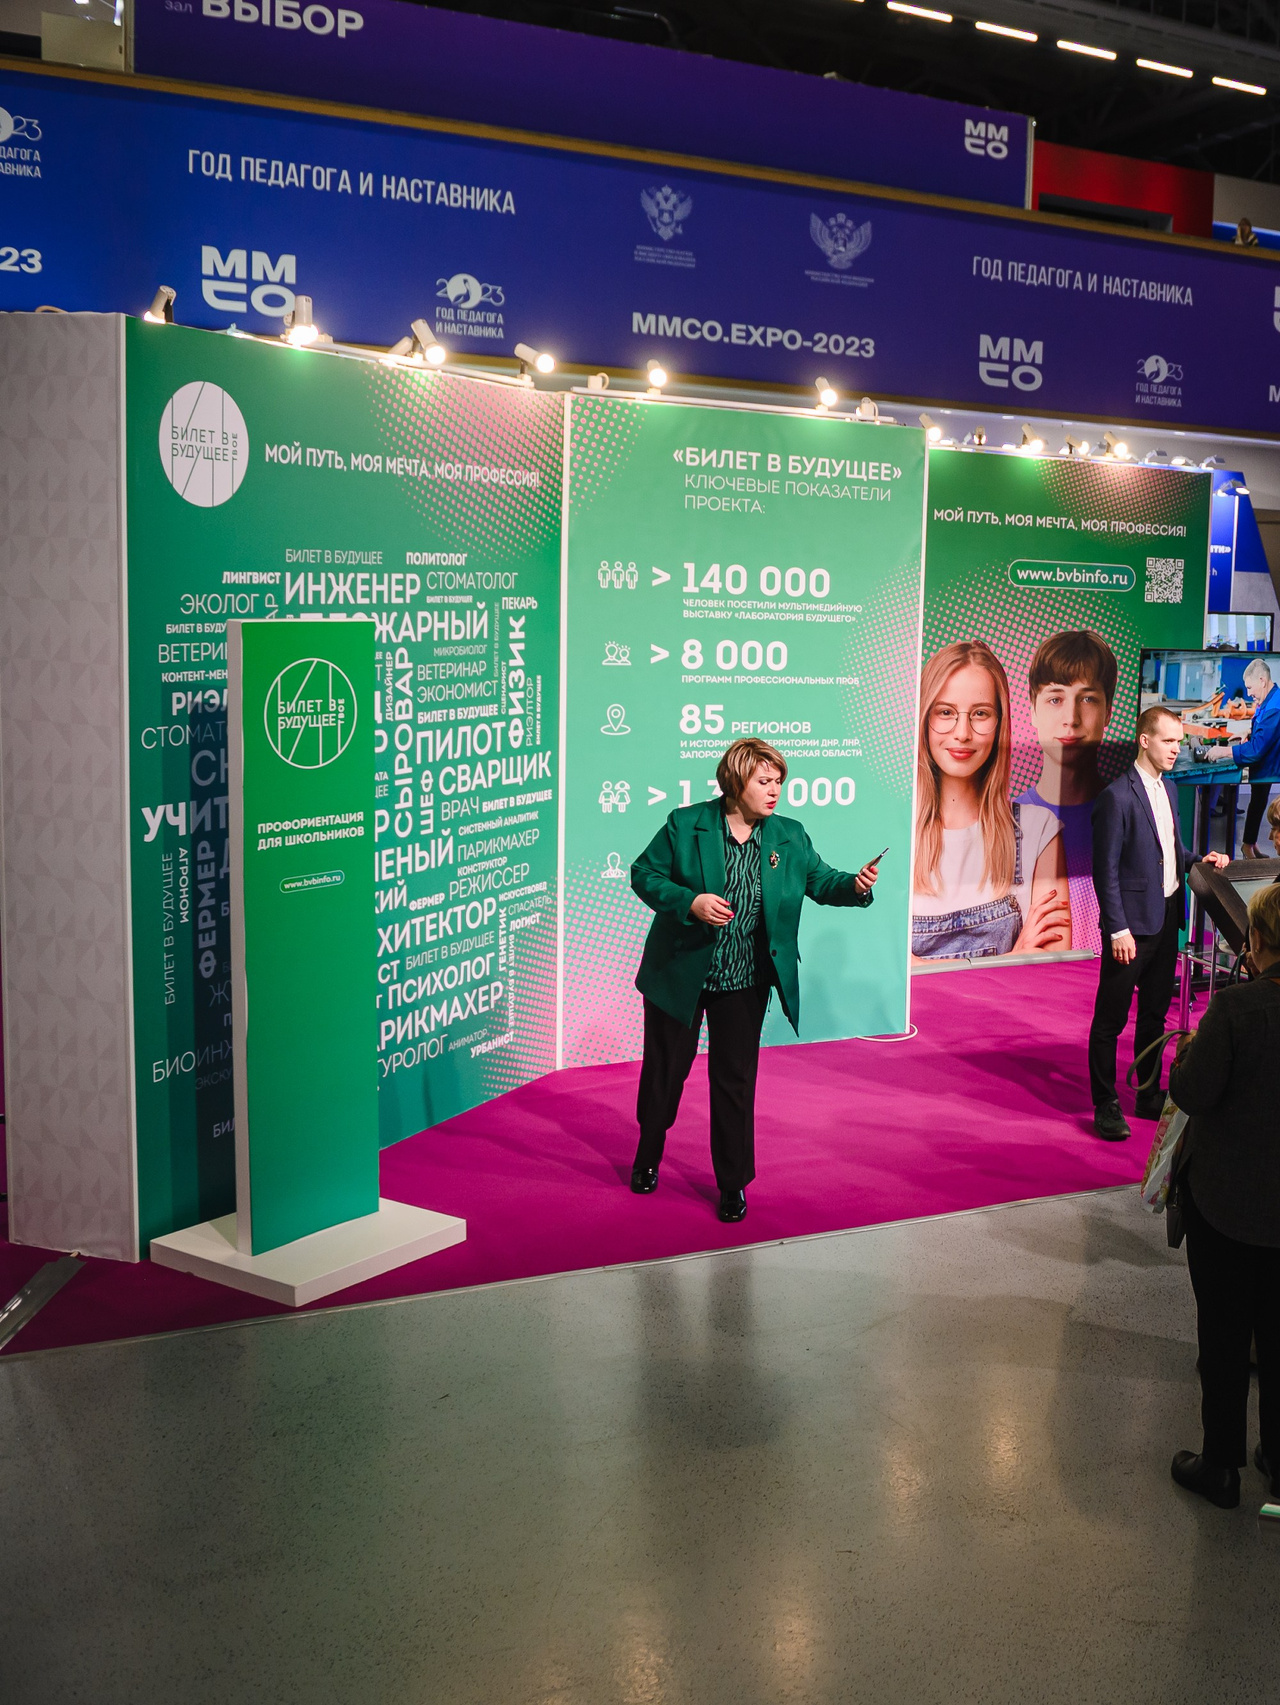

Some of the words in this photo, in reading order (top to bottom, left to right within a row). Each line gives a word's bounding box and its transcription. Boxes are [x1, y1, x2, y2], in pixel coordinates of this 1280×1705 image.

[202, 0, 364, 38] ВЫБОР
[188, 149, 233, 182] ГОД
[240, 156, 352, 195] ПЕДАГОГА
[359, 171, 374, 196] И
[382, 176, 516, 215] НАСТАВНИКА
[0, 246, 42, 274] 23
[973, 256, 1003, 282] ГОД
[1007, 262, 1083, 291] ПЕДАГОГА
[1087, 271, 1098, 293] И
[1103, 275, 1193, 307] НАСТАВНИКА
[436, 306, 454, 321] ГОД
[457, 309, 504, 325] ПЕДАГОГА
[436, 321, 442, 333] И
[444, 322, 504, 338] НАСТАВНИКА
[632, 312, 875, 358] MMCO.EXPO-2023
[171, 425, 216, 444] БИЛЕТ
[222, 431, 229, 446] В
[171, 443, 229, 462] БУДУЩЕЕ
[265, 440, 302, 466] МОЙ
[306, 447, 347, 472] ПУТЬ,
[350, 452, 383, 473] МОЯ
[386, 456, 431, 479] МЕЧТА,
[434, 461, 463, 480] МОЯ
[465, 464, 540, 488] ПРОФЕССИЯ!
[673, 446, 761, 470] «БИЛЕТ
[767, 453, 782, 472] В
[788, 456, 903, 482] БУДУЩЕЕ»
[685, 473, 780, 495] КЛЮЧЕВЫЕ
[785, 481, 891, 502] ПОКАЗАТЕЛИ
[684, 494, 766, 515] ПРОЕКТА:
[933, 507, 964, 522] МОЙ
[967, 510, 1002, 526] ПУТЬ,
[1005, 514, 1033, 527] МОЯ
[1036, 515, 1078, 531] МЕЧТА,
[1081, 518, 1108, 532] МОЯ
[1110, 520, 1187, 538] ПРОФЕССИЯ!
[285, 548, 322, 563] БИЛЕТ
[324, 550, 332, 563] В
[334, 550, 383, 565] БУДУЩЕЕ
[406, 551, 468, 566] ПОЛИТОЛОГ
[222, 571, 282, 585] ЛИНГВИСТ
[285, 571, 421, 606] ИНЖЕНЕР
[426, 571, 519, 591] СТОМАТОЛОГ
[682, 561, 748, 596] 140
[759, 565, 831, 599] 000
[1017, 567, 1129, 586] www.bvbinfo.ru
[180, 593, 260, 615] ЭКОЛОГ
[501, 596, 538, 610] ПЕКАРЬ
[683, 598, 726, 608] ЧЕЛОВЕК
[727, 600, 777, 610] ПОСЕТИЛИ
[778, 602, 863, 613] МУЛЬТИМЕДИЙНУЮ
[683, 609, 733, 619] ВЫСТАВКУ
[734, 611, 804, 622] «ЛАБОРАТОРИЯ
[158, 641, 228, 664] ВЕТЕРИ
[433, 644, 488, 658] МИКРОБИОЛОГ
[681, 638, 704, 670] 8
[715, 639, 788, 672] 000
[161, 669, 229, 683] КОНТЕНТ-МЕН
[417, 660, 487, 682] ВЕТЕРИНАР
[508, 615, 526, 749] ФИЗИК
[681, 674, 732, 684] ПРОГРАММ
[734, 675, 835, 685] ПРОФЕССИОНАЛЬНЫХ
[836, 676, 860, 685] ПРОБ
[385, 651, 394, 722] ДИЗАЙНЕР
[416, 680, 499, 704] ЭКОНОМИСТ
[500, 660, 508, 715] СЦЕНАРИСТ
[277, 699, 323, 715] БИЛЕТ
[329, 698, 337, 712] В
[417, 708, 448, 725] БИЛЕТ
[449, 708, 456, 721] В
[457, 703, 499, 720] БУДУЩЕЕ
[526, 677, 534, 747] РИЭЛТОР
[679, 703, 725, 735] 85
[731, 721, 812, 735] РЕГИОНОВ
[277, 714, 337, 730] БУДУЩЕЕ
[394, 647, 413, 839] СЫРОВАР
[416, 721, 506, 765] ПИЛОТ
[680, 740, 688, 748] И
[689, 739, 735, 749] ИСТОРИЧ
[680, 750, 726, 759] ЗАПОРОЖ
[822, 748, 863, 758] ОБЛАСТИ
[439, 750, 552, 796] СВАРЩИК
[420, 769, 434, 836] ШЕФ
[441, 796, 480, 822] ВРАЧ
[482, 797, 508, 813] БИЛЕТ
[509, 796, 516, 808] В
[516, 789, 553, 807] БУДУЩЕЕ
[141, 796, 229, 843] УЧИТ
[257, 811, 365, 835] ПРОФОРИЕНТАЦИЯ
[458, 816, 503, 836] СИСТЕМНЫЙ
[503, 810, 540, 827] АНАЛИТИК
[257, 837, 283, 852] ДЛЯ
[285, 826, 365, 848] ШКОЛЬНИКОВ
[457, 828, 540, 863] ПАРИКМАХЕР
[457, 856, 508, 877] КОНСТРУКТОР
[162, 852, 175, 932] БУДУЩЕЕ
[179, 847, 190, 924] АГРОНОМ
[283, 873, 342, 891] www.bvbinfo.ru
[449, 862, 530, 901] РЕЖИССЕР
[498, 881, 548, 902] ИСКУССТВОВЕД
[197, 840, 217, 979] ФЕРМЕР
[408, 892, 446, 912] ФЕРМЕР
[508, 895, 552, 916] СПАСАТЕЛЬ
[377, 896, 497, 958] ХИТЕКТОР
[509, 912, 541, 932] ЛОГИСТ
[164, 936, 175, 947] В
[405, 947, 440, 971] БИЛЕТ
[441, 945, 449, 960] В
[450, 931, 495, 957] БУДУЩЕЕ
[498, 906, 508, 972] ГЕНЕТИК
[164, 952, 176, 1005] БИЛЕТ
[388, 952, 496, 1010] ПСИХОЛОГ
[377, 981, 504, 1052] РИКМАХЕР
[448, 1028, 488, 1052] АНИМАТОР
[470, 1031, 514, 1059] УРБАНИСТ
